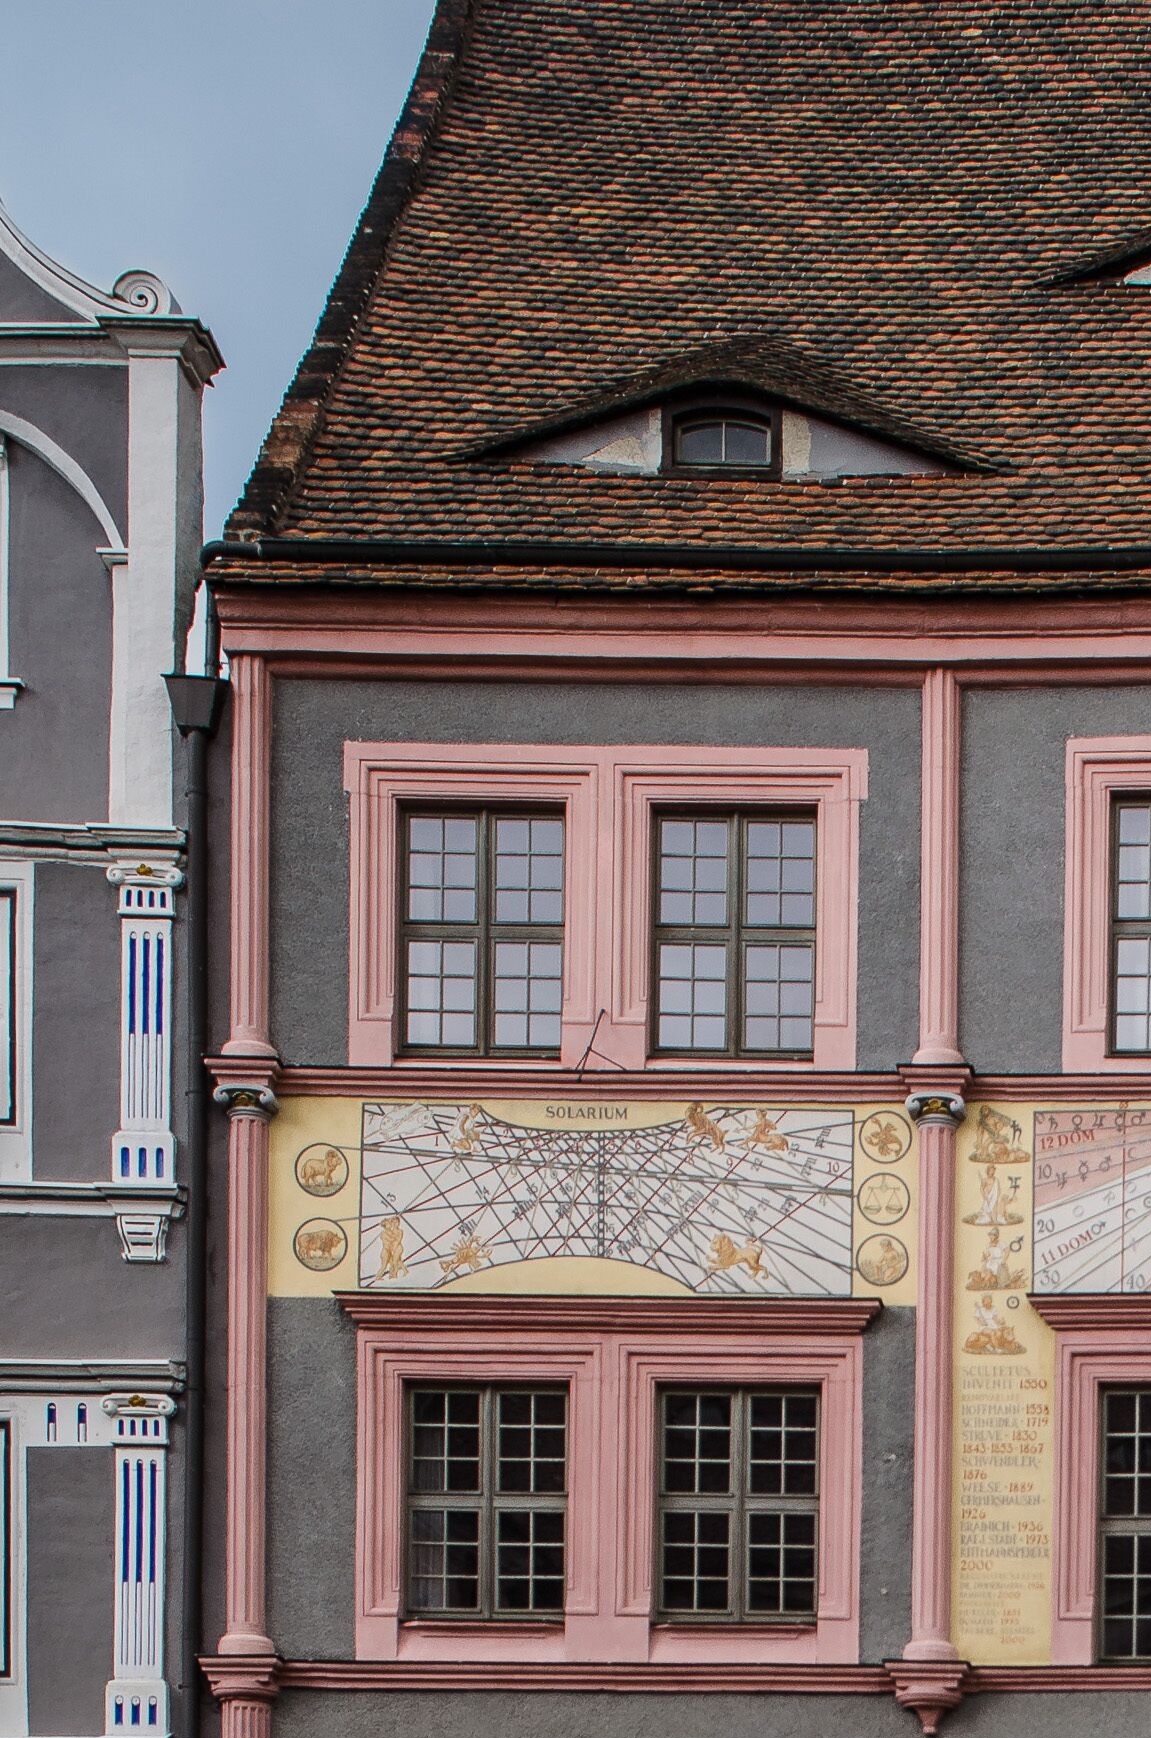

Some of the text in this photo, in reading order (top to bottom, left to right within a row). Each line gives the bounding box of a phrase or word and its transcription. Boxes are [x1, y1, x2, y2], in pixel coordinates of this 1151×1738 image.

[545, 1105, 628, 1120] SOLARIUM
[1040, 1128, 1095, 1150] 12 DOM
[826, 1161, 840, 1175] 10
[1038, 1164, 1053, 1180] 10
[1037, 1218, 1055, 1233] 20
[1041, 1230, 1094, 1266] 11 DOM
[1040, 1269, 1060, 1286] 30
[1126, 1273, 1145, 1289] 40
[961, 1430, 1003, 1442] STRUVE
[960, 1559, 994, 1571] 2000
